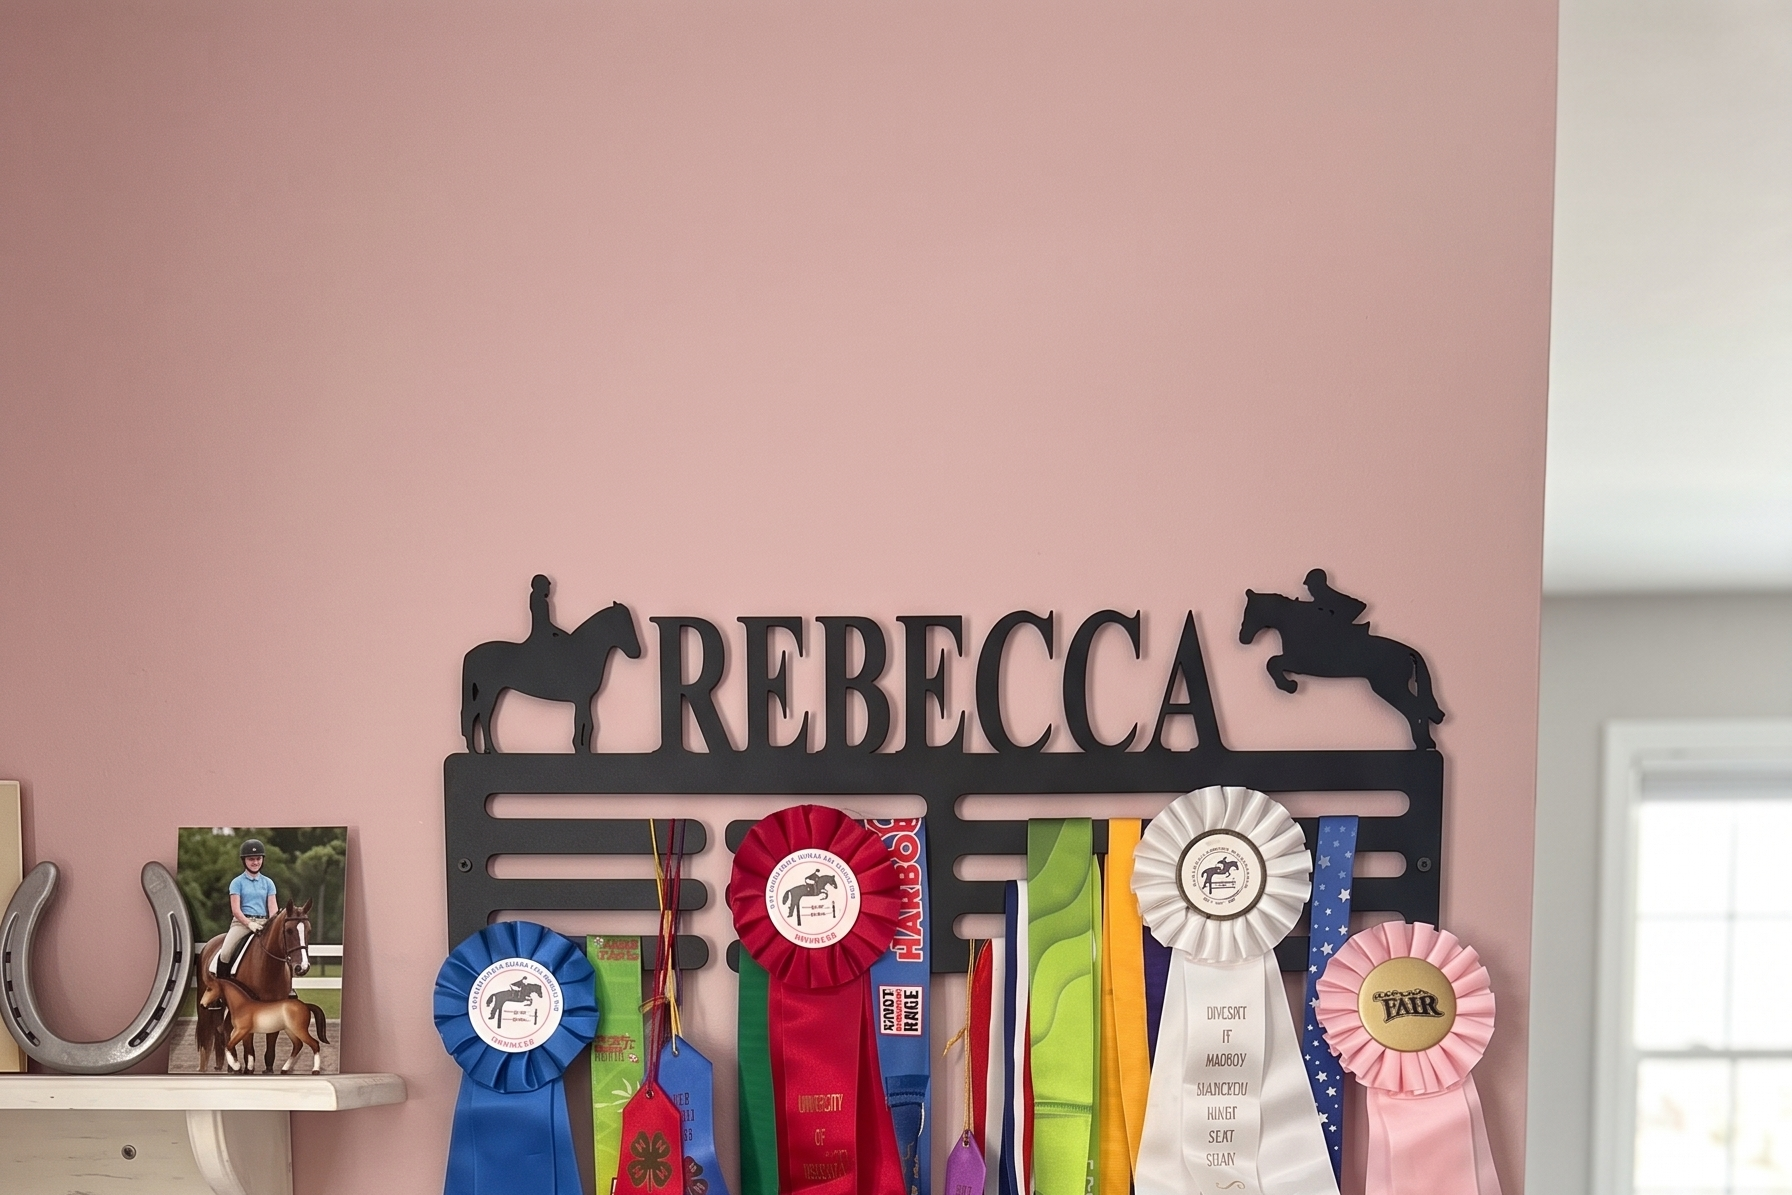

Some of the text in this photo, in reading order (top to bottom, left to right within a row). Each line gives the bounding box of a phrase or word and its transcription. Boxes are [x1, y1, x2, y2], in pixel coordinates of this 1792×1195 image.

[648, 608, 1229, 753] REBECCA
[1383, 995, 1443, 1022] FAIR
[814, 1128, 826, 1146] OF
